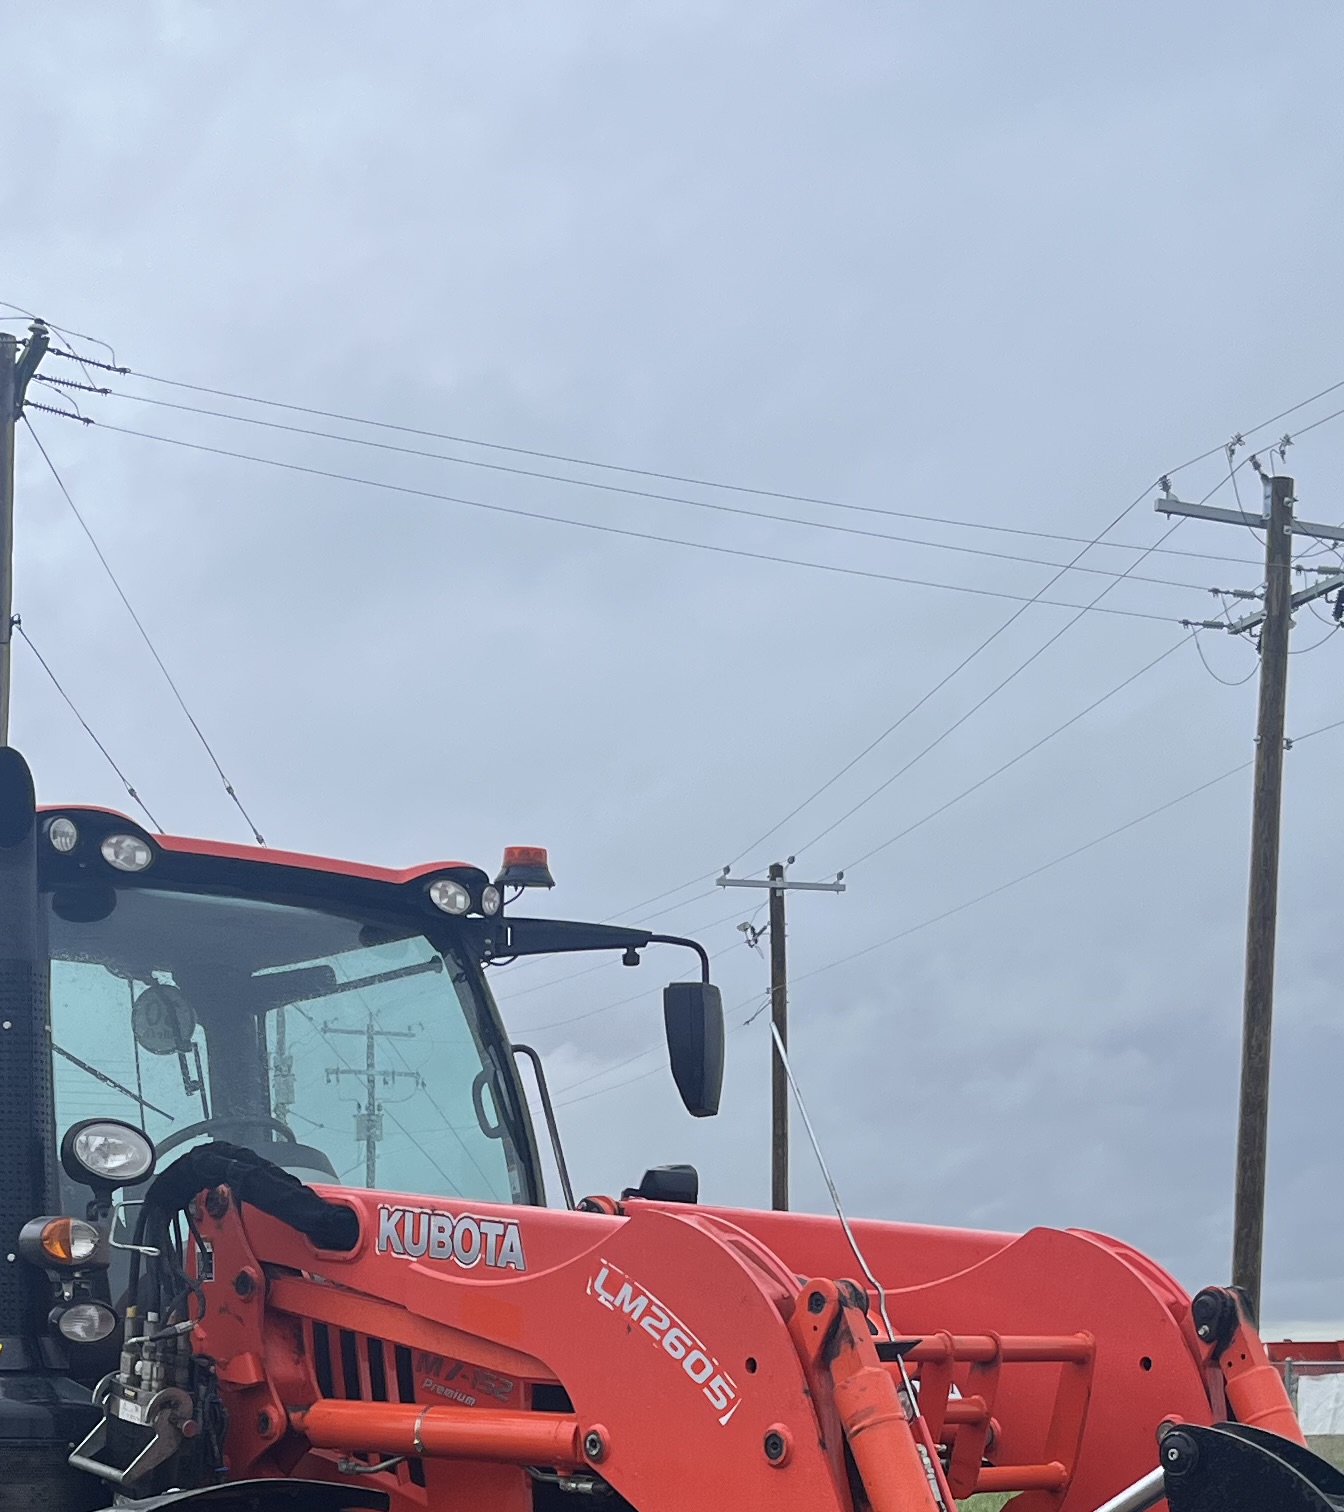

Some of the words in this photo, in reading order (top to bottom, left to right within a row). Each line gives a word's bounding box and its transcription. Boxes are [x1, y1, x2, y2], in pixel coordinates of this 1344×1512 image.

[377, 1205, 526, 1271] KUBOTA
[592, 1266, 736, 1411] LM2605
[422, 1377, 477, 1407] Premium
